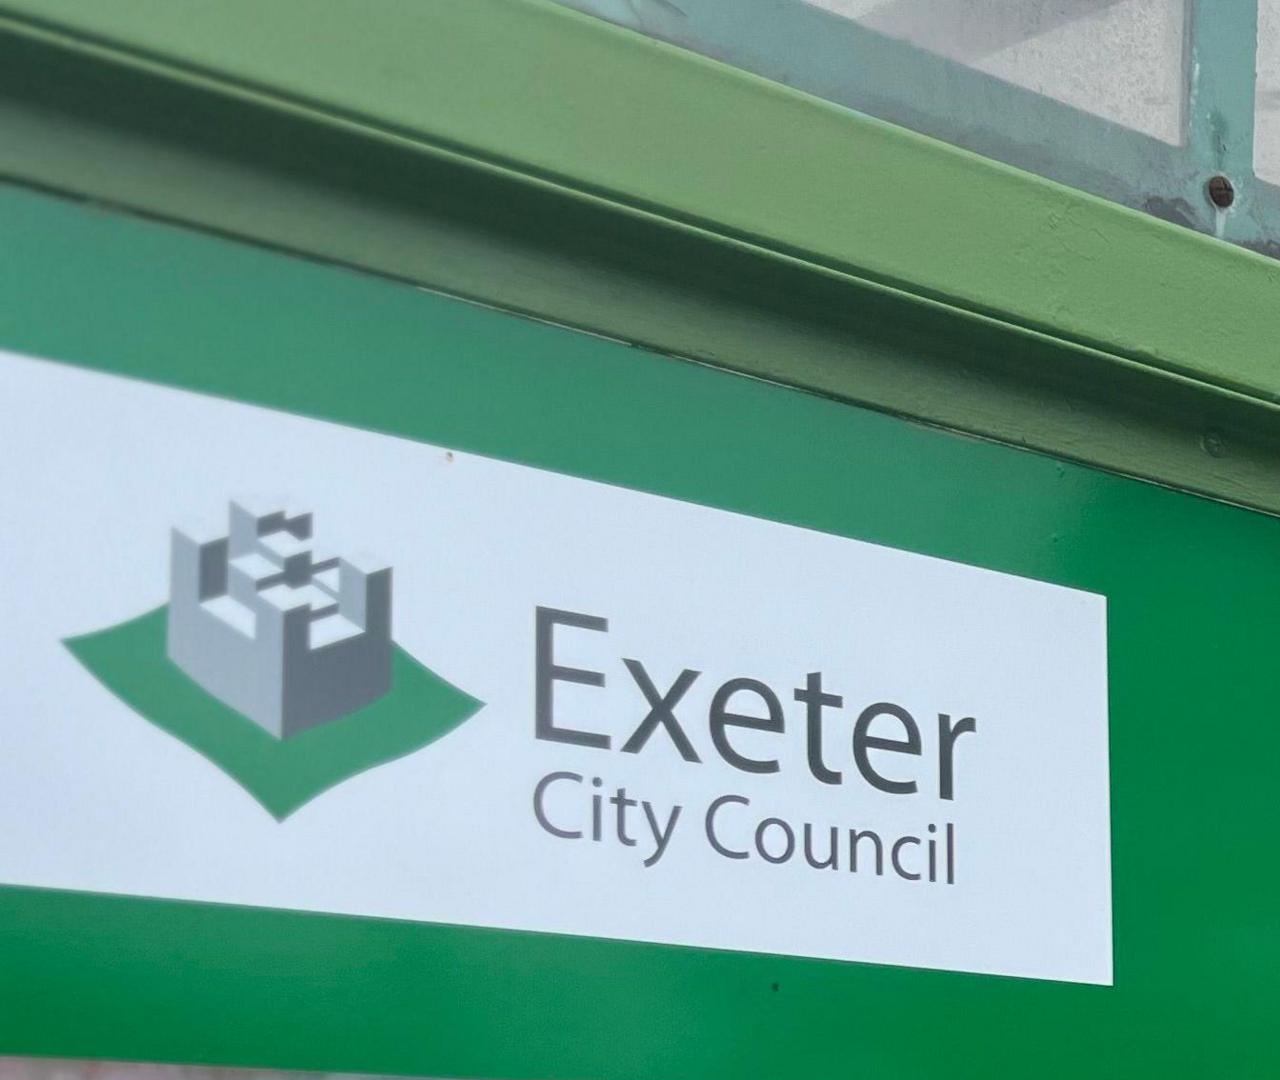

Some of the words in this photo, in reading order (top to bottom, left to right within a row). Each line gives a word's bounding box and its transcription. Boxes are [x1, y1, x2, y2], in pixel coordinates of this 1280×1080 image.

[535, 605, 977, 801] Exeter
[533, 771, 682, 868] City
[705, 795, 954, 885] Council
